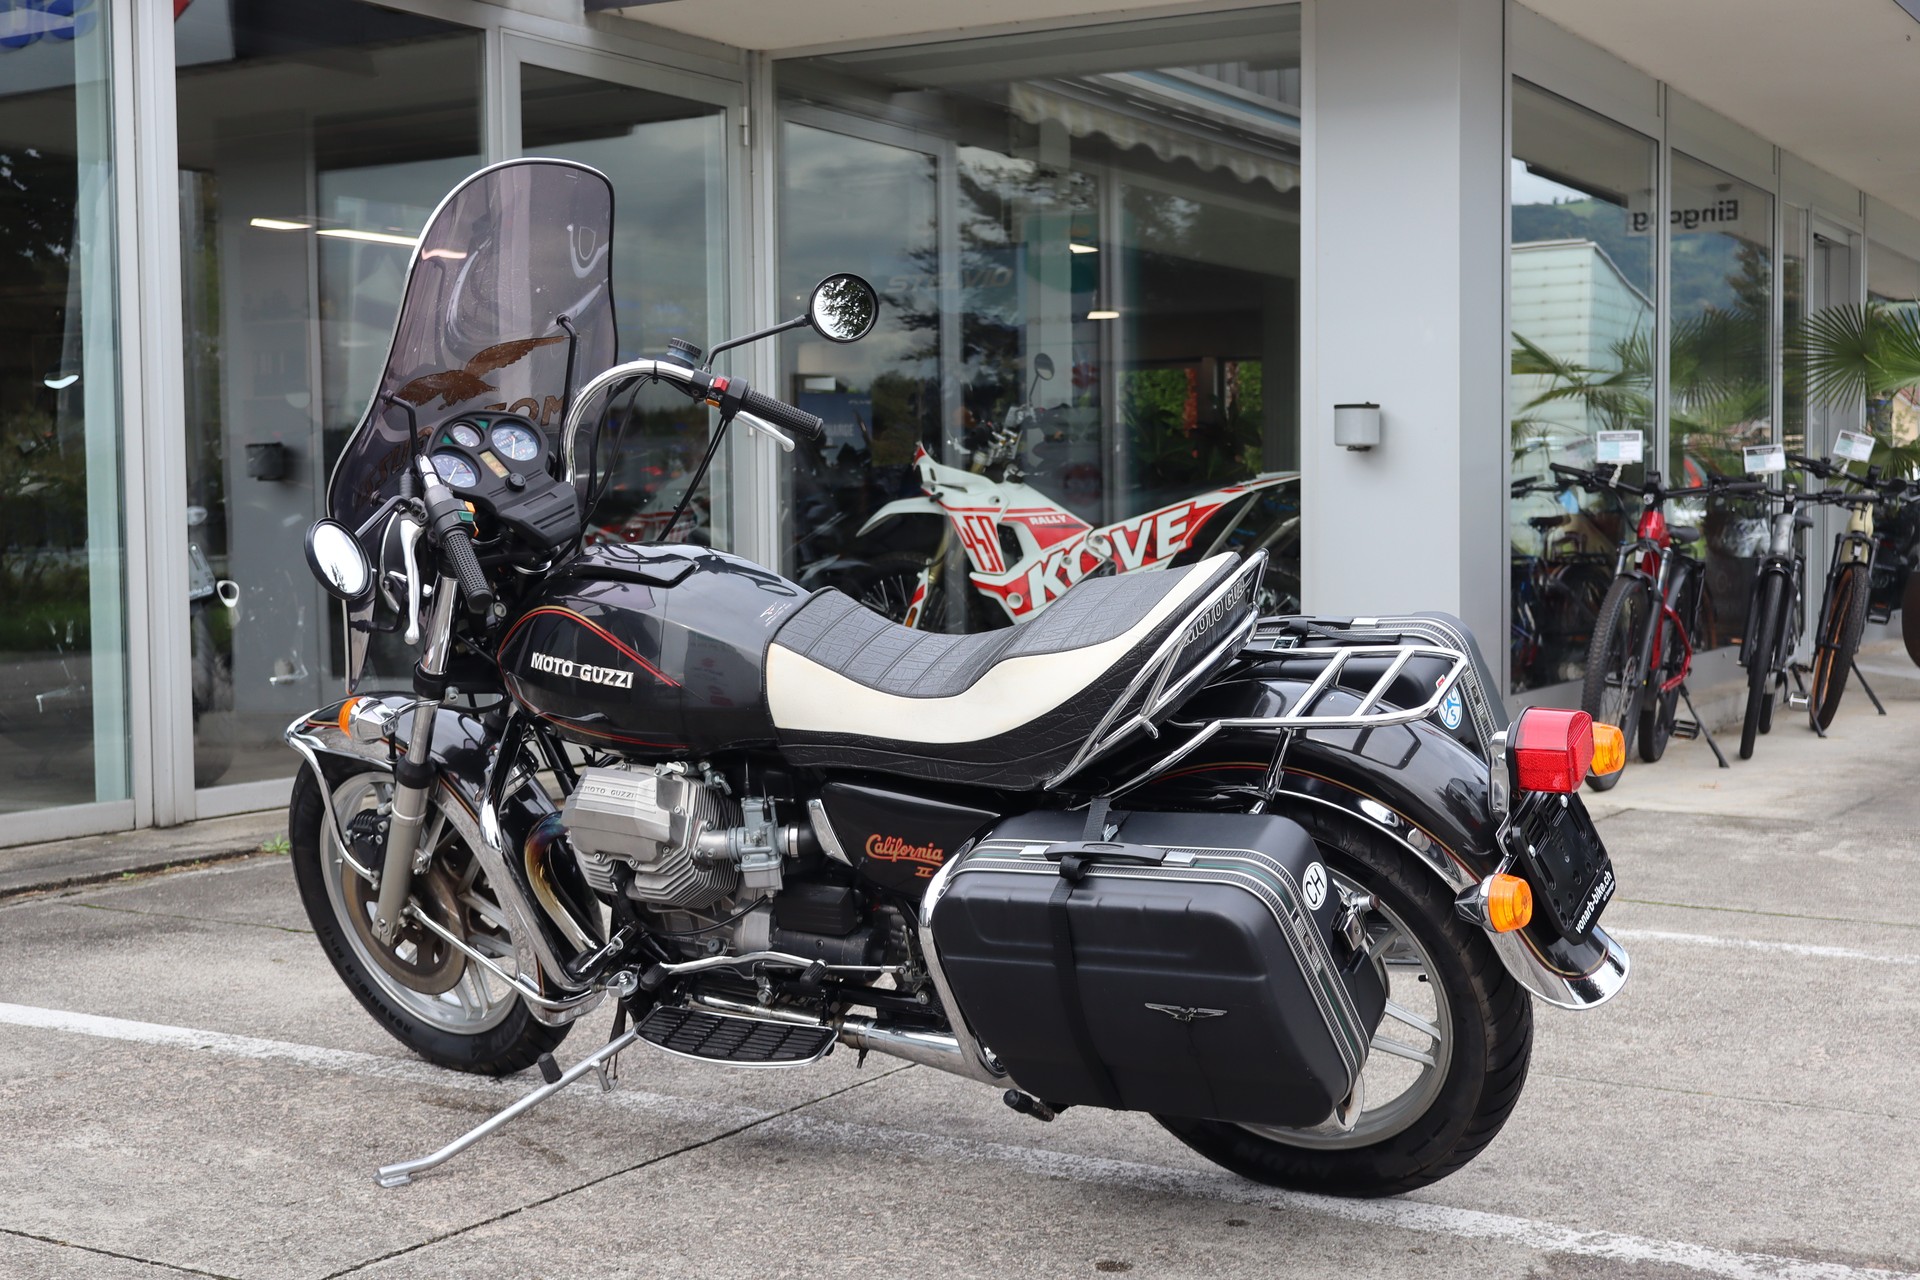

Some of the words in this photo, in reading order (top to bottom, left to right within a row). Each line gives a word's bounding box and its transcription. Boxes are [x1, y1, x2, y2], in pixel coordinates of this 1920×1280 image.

[1029, 514, 1067, 526] RALLY
[1027, 504, 1192, 609] KOVE
[530, 651, 574, 678] MOTO
[579, 664, 634, 689] GUZZI
[584, 785, 606, 794] MOTO
[610, 789, 635, 799] GUZZI
[865, 833, 945, 867] California
[914, 865, 934, 878] II
[1305, 867, 1325, 905] CH
[1575, 870, 1613, 934] vonarb-bike.ch
